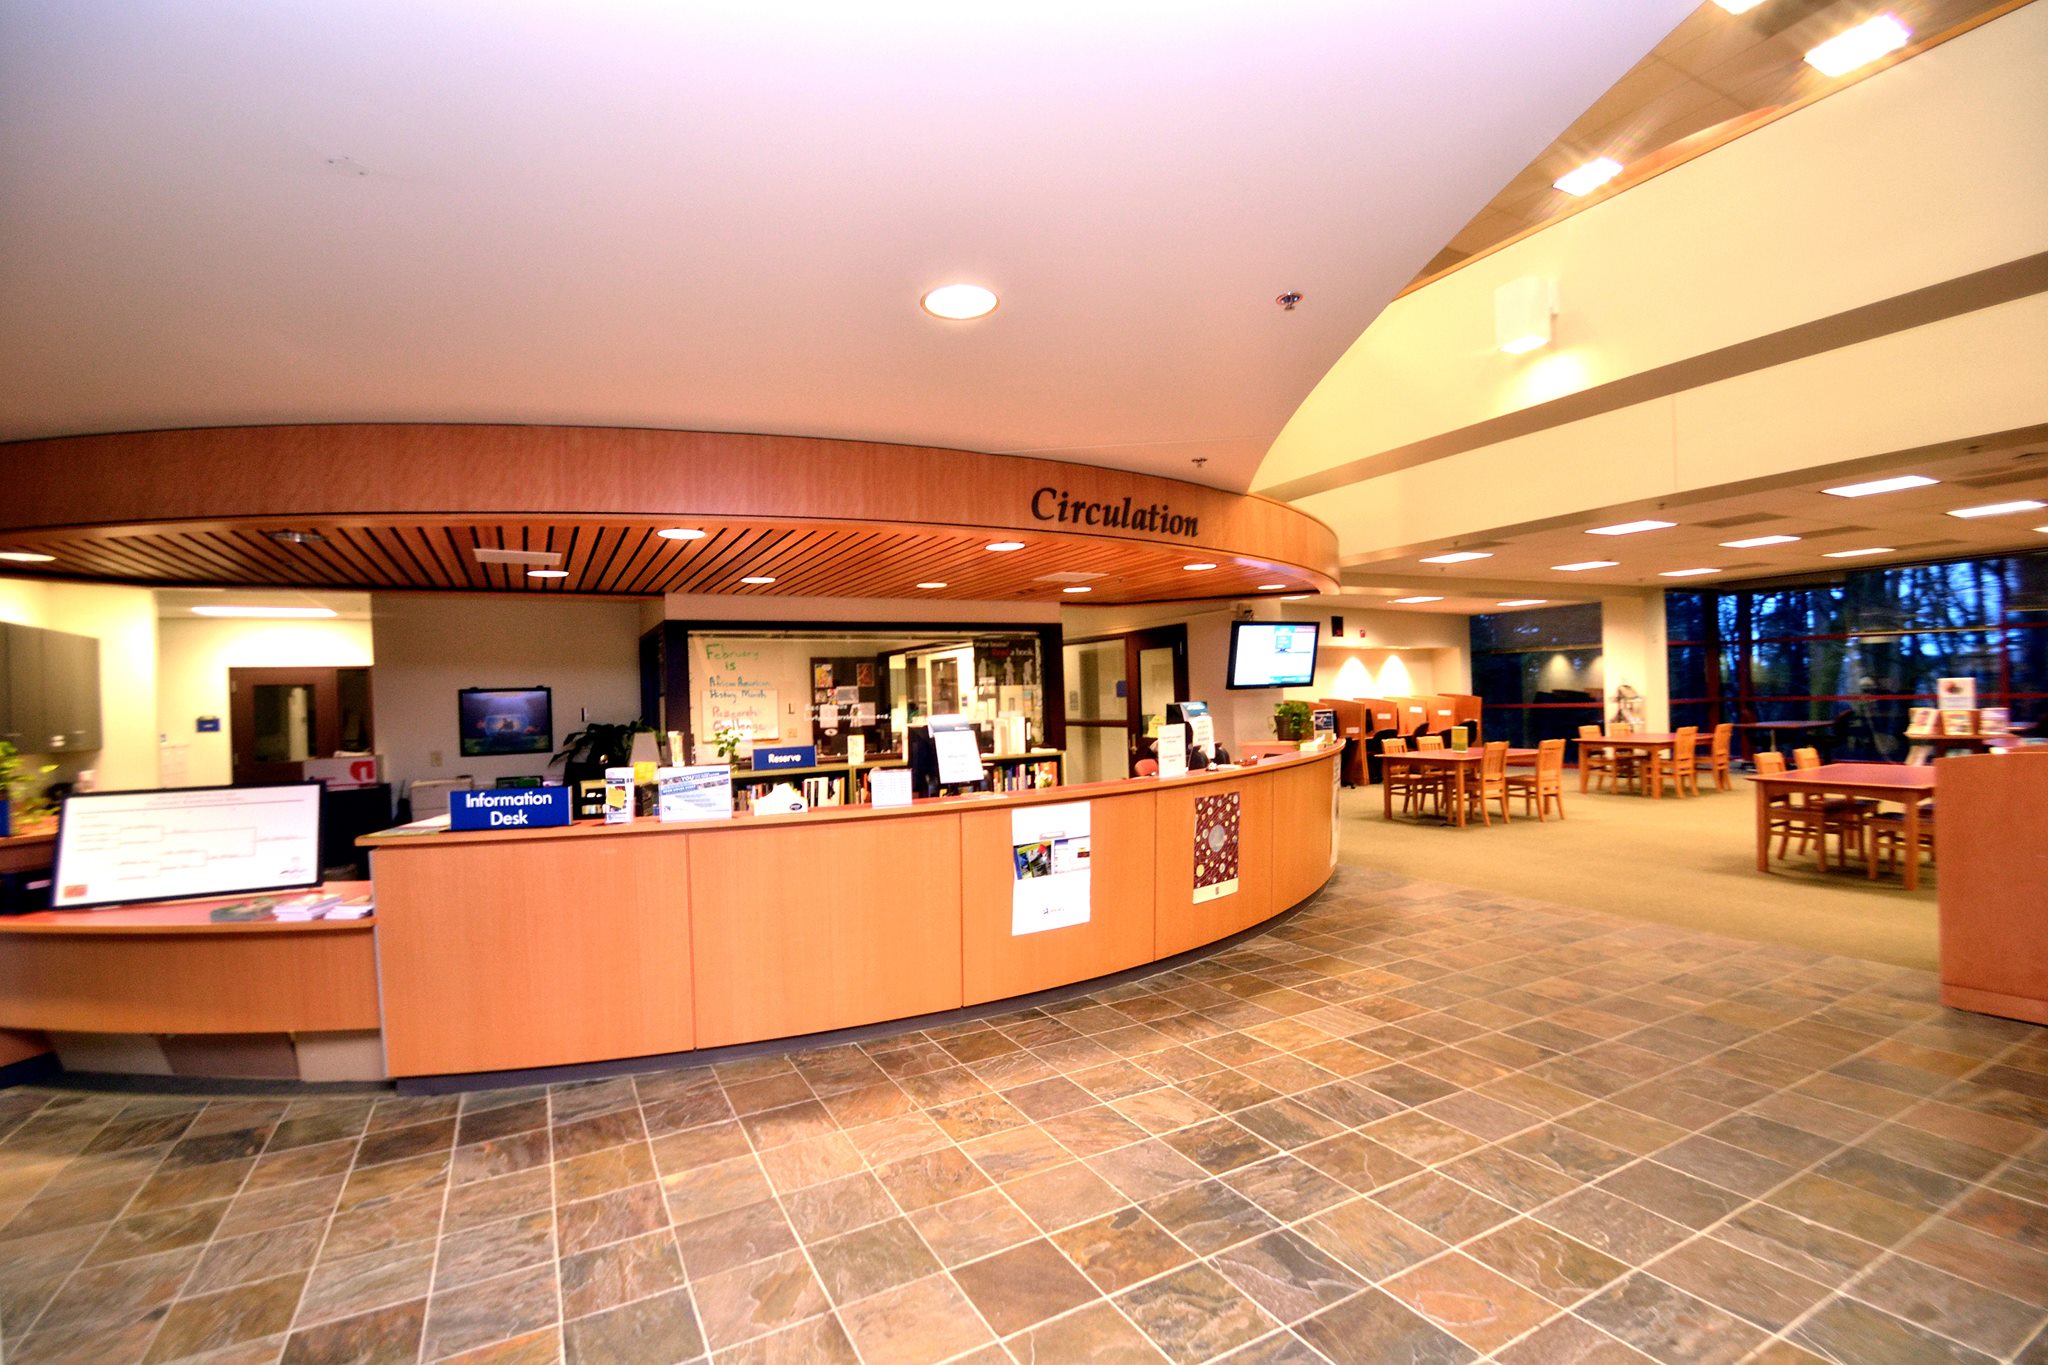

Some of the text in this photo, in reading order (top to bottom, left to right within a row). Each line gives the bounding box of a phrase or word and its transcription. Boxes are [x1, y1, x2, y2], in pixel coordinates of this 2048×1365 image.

[1031, 487, 1199, 538] Circulation
[705, 643, 759, 660] February
[725, 662, 736, 671] is
[768, 753, 802, 764] Reserve
[465, 790, 552, 808] Information
[490, 809, 528, 826] Desk
